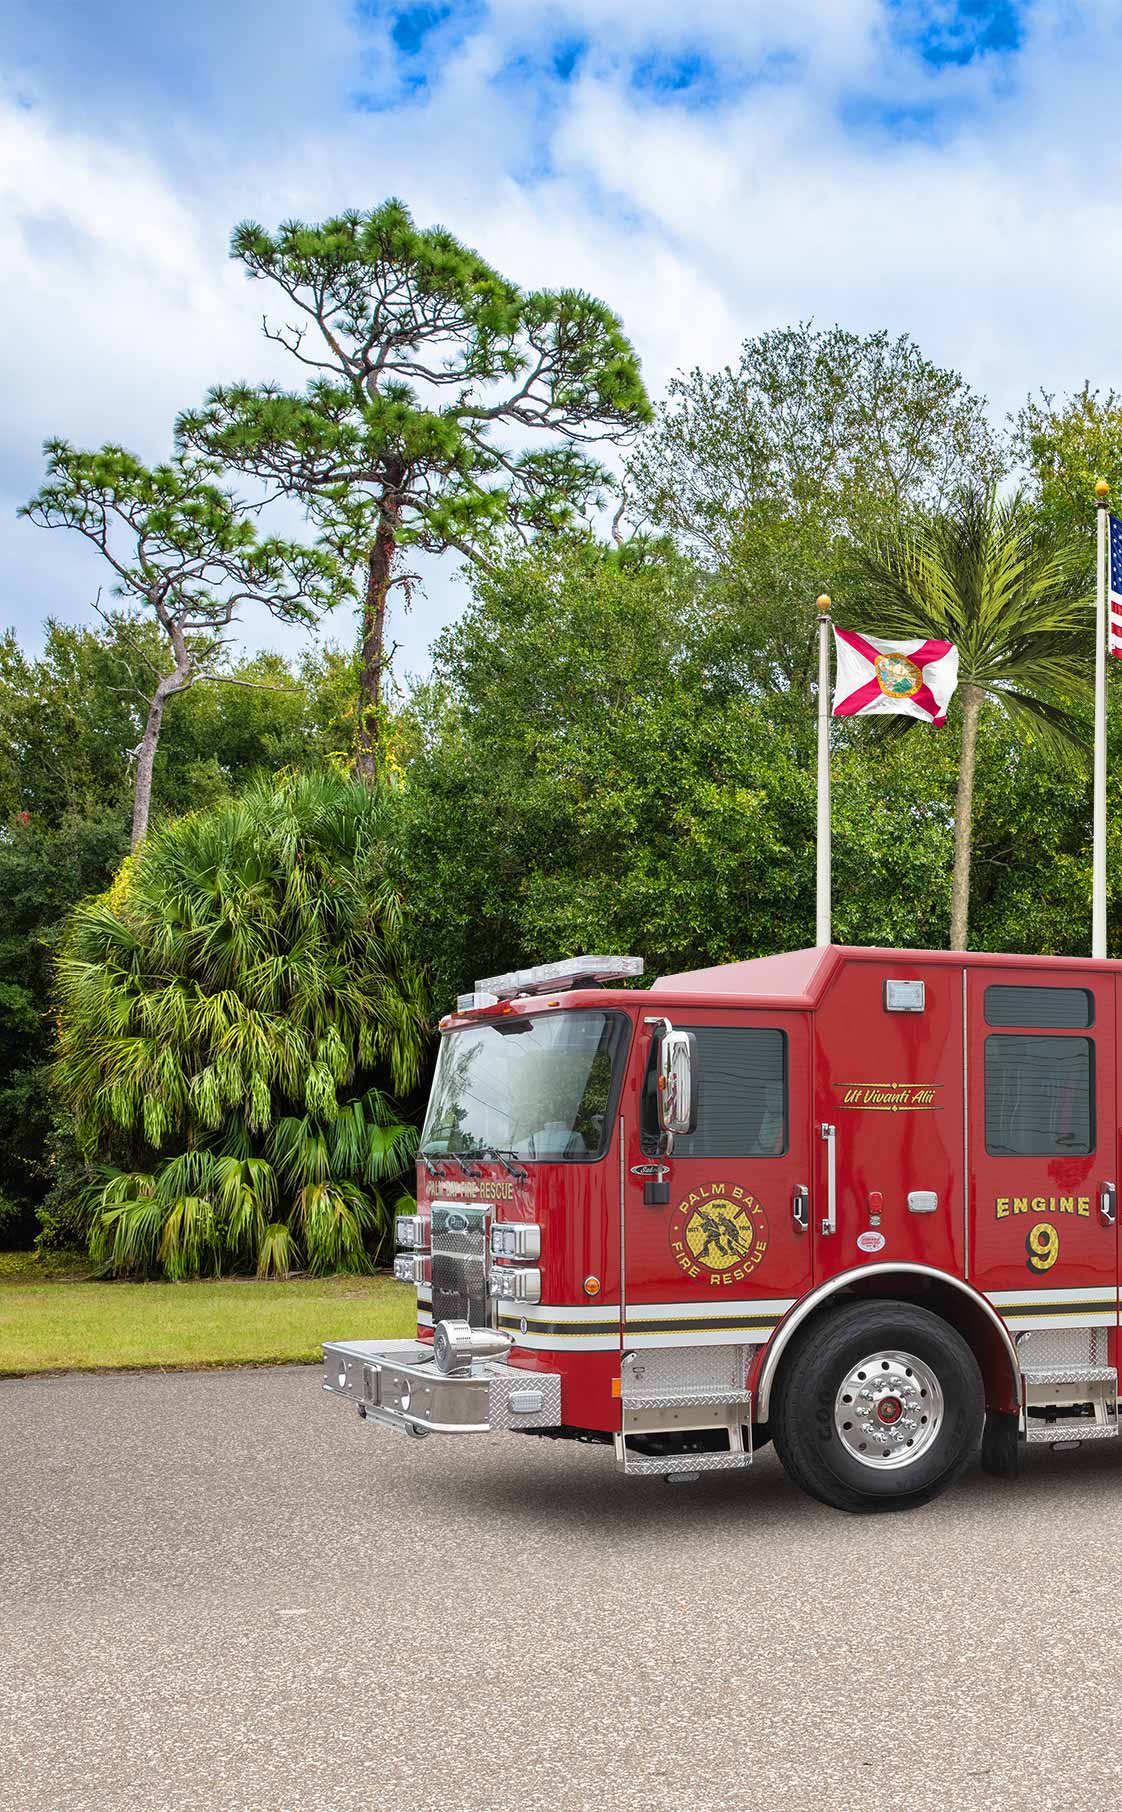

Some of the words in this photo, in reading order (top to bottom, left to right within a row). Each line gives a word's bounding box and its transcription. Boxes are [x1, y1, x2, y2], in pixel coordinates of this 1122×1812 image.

[863, 1089, 912, 1104] Vivanti
[911, 1089, 936, 1104] Alii
[480, 1182, 514, 1200] RESCUE
[679, 1184, 725, 1214] PALM
[732, 1186, 763, 1215] BAY
[995, 1196, 1090, 1219] ENGINE
[1027, 1222, 1059, 1272] 9
[672, 1241, 700, 1278] FIRE
[710, 1241, 767, 1285] RESCUE
